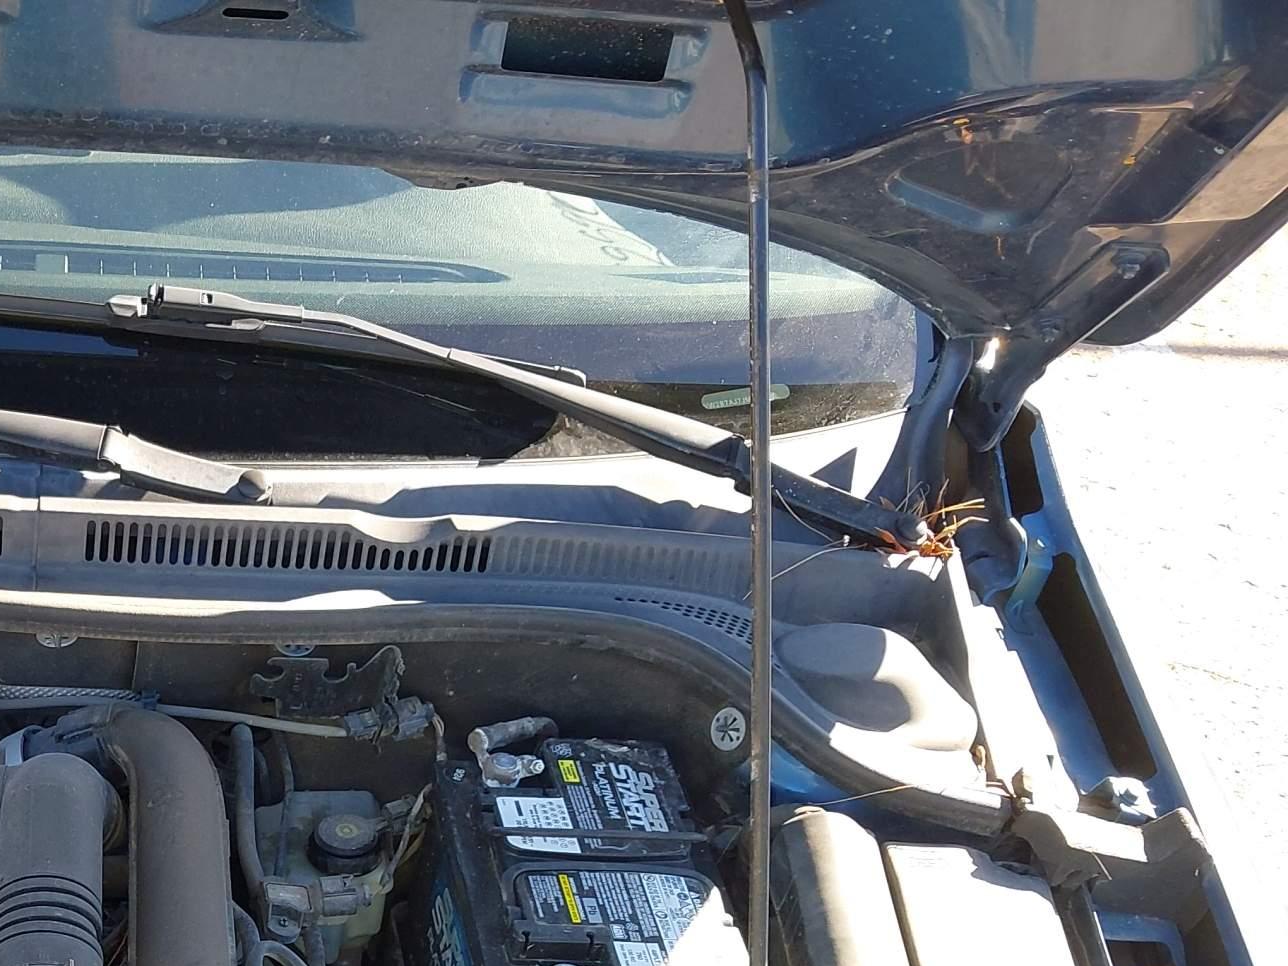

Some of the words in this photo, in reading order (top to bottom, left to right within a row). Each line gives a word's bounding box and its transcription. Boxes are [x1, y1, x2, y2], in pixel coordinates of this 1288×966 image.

[592, 763, 622, 820] PLATINUM
[608, 762, 652, 832] START
[638, 772, 669, 832] SUPER
[588, 905, 598, 915] Pb
